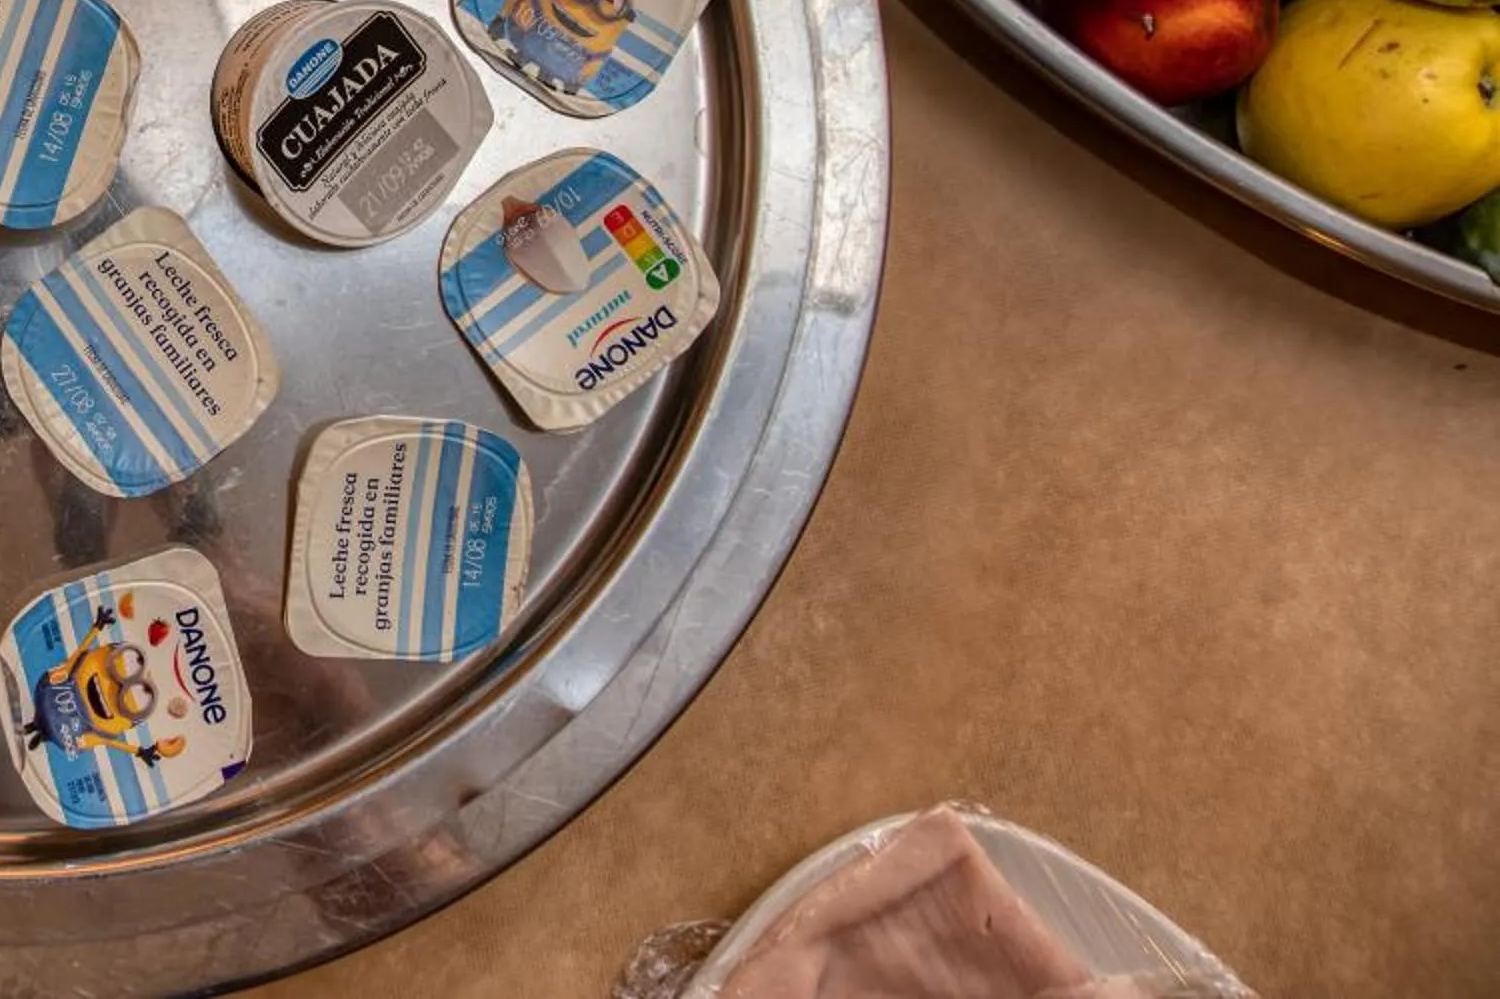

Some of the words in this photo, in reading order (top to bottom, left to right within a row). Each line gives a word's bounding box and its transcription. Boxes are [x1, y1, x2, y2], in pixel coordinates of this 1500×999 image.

[280, 44, 401, 160] CUAJADA
[289, 42, 334, 90] DANONE
[40, 111, 72, 162] 14/08
[98, 257, 153, 327] granjas
[150, 323, 221, 417] familiares
[138, 270, 198, 347] recogida
[196, 347, 216, 373] en
[154, 252, 198, 307] Leche
[194, 305, 238, 362] fresca
[565, 289, 632, 349] natural
[574, 305, 678, 391] DANONE
[336, 472, 358, 533] fresca
[355, 506, 377, 596] recogida
[368, 478, 379, 503] en
[379, 442, 407, 547] familiares
[330, 538, 349, 600] Leche
[375, 552, 393, 631] granjas
[462, 538, 487, 587] 14/08
[175, 608, 227, 725] DANONE
